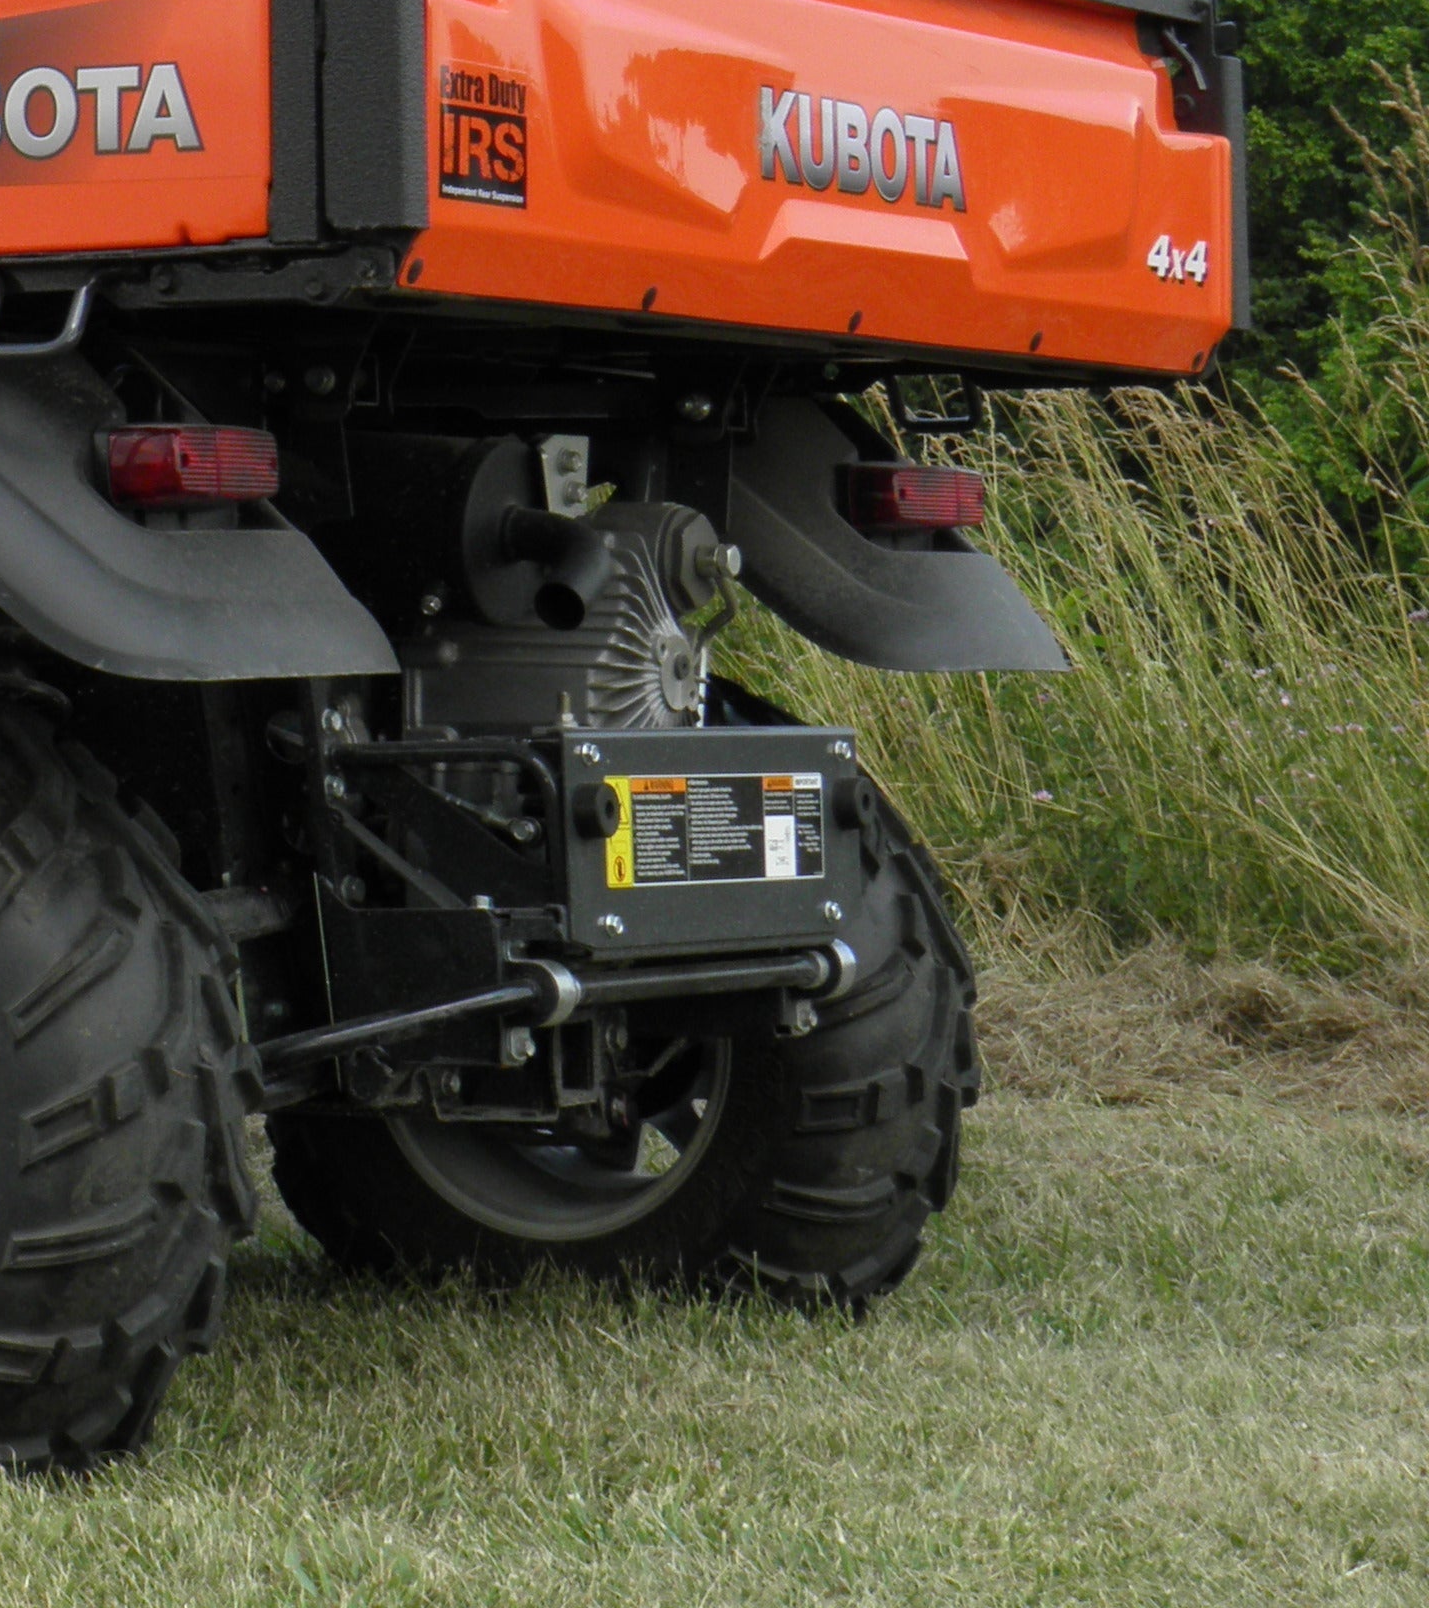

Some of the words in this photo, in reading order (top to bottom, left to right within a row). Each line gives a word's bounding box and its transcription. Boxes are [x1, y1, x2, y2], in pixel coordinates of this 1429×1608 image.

[440, 65, 484, 104] Extra
[489, 73, 526, 114] Duty
[443, 112, 525, 183] IRS
[759, 85, 967, 211] KUBOTA
[1147, 234, 1208, 284] 4x4
